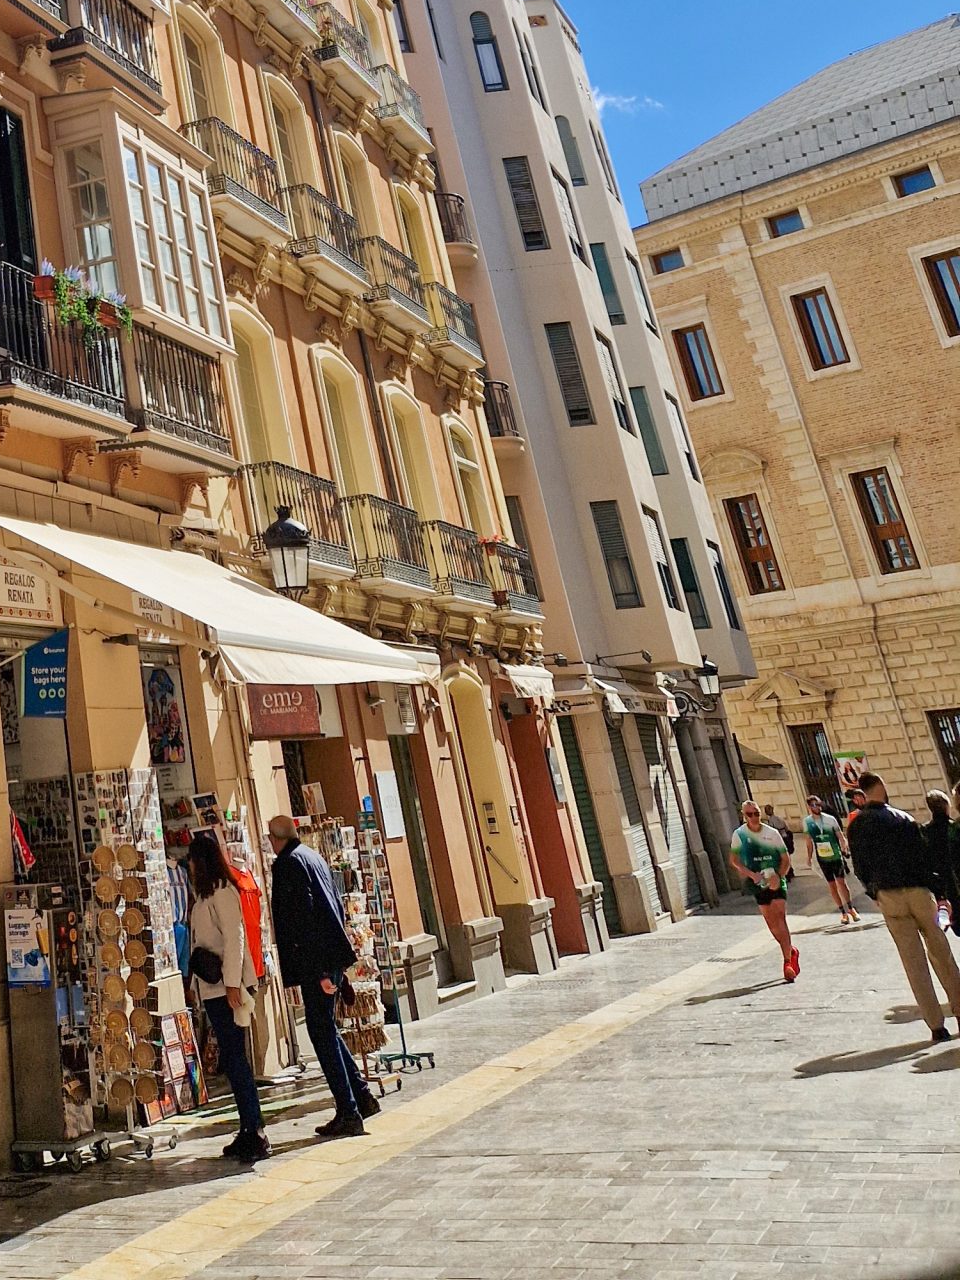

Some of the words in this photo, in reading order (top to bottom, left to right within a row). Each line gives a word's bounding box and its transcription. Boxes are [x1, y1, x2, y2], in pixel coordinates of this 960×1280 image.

[4, 572, 35, 588] REGALOS
[7, 589, 35, 604] RENATA
[138, 597, 163, 611] REGALOS
[31, 667, 49, 675] Store
[50, 667, 66, 676] your
[33, 676, 49, 685] bags
[50, 676, 66, 684] here
